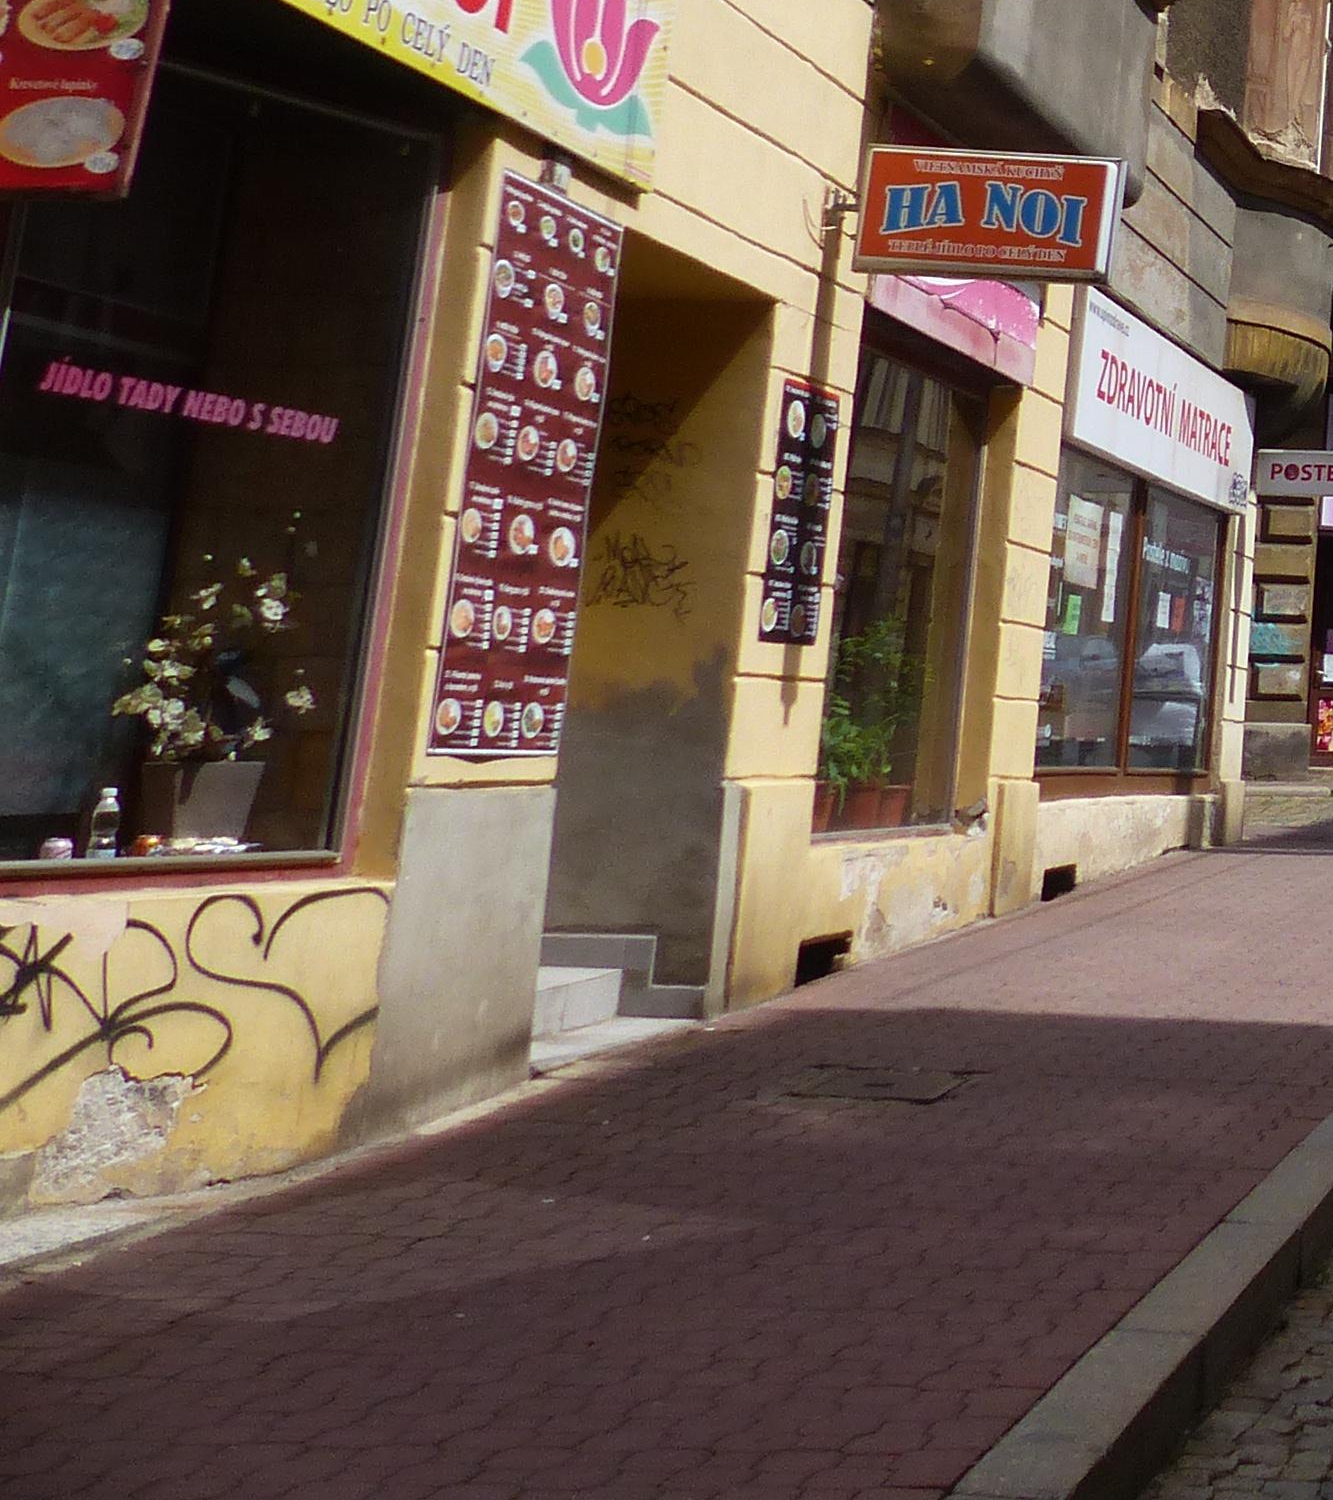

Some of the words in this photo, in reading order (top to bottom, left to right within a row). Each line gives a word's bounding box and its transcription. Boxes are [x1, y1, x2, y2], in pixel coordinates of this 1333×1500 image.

[401, 12, 451, 63] CELÝ
[457, 42, 496, 88] DEN
[879, 180, 965, 235] HA
[981, 180, 1088, 247] NOI
[39, 356, 113, 401] JÍDLO
[116, 376, 184, 414] TADY
[181, 389, 248, 427] NEBO
[247, 403, 267, 431] S
[264, 405, 341, 444] SEBOU
[1096, 348, 1178, 438] ZDRAVOTNÍ
[1178, 398, 1233, 468] MATRACE
